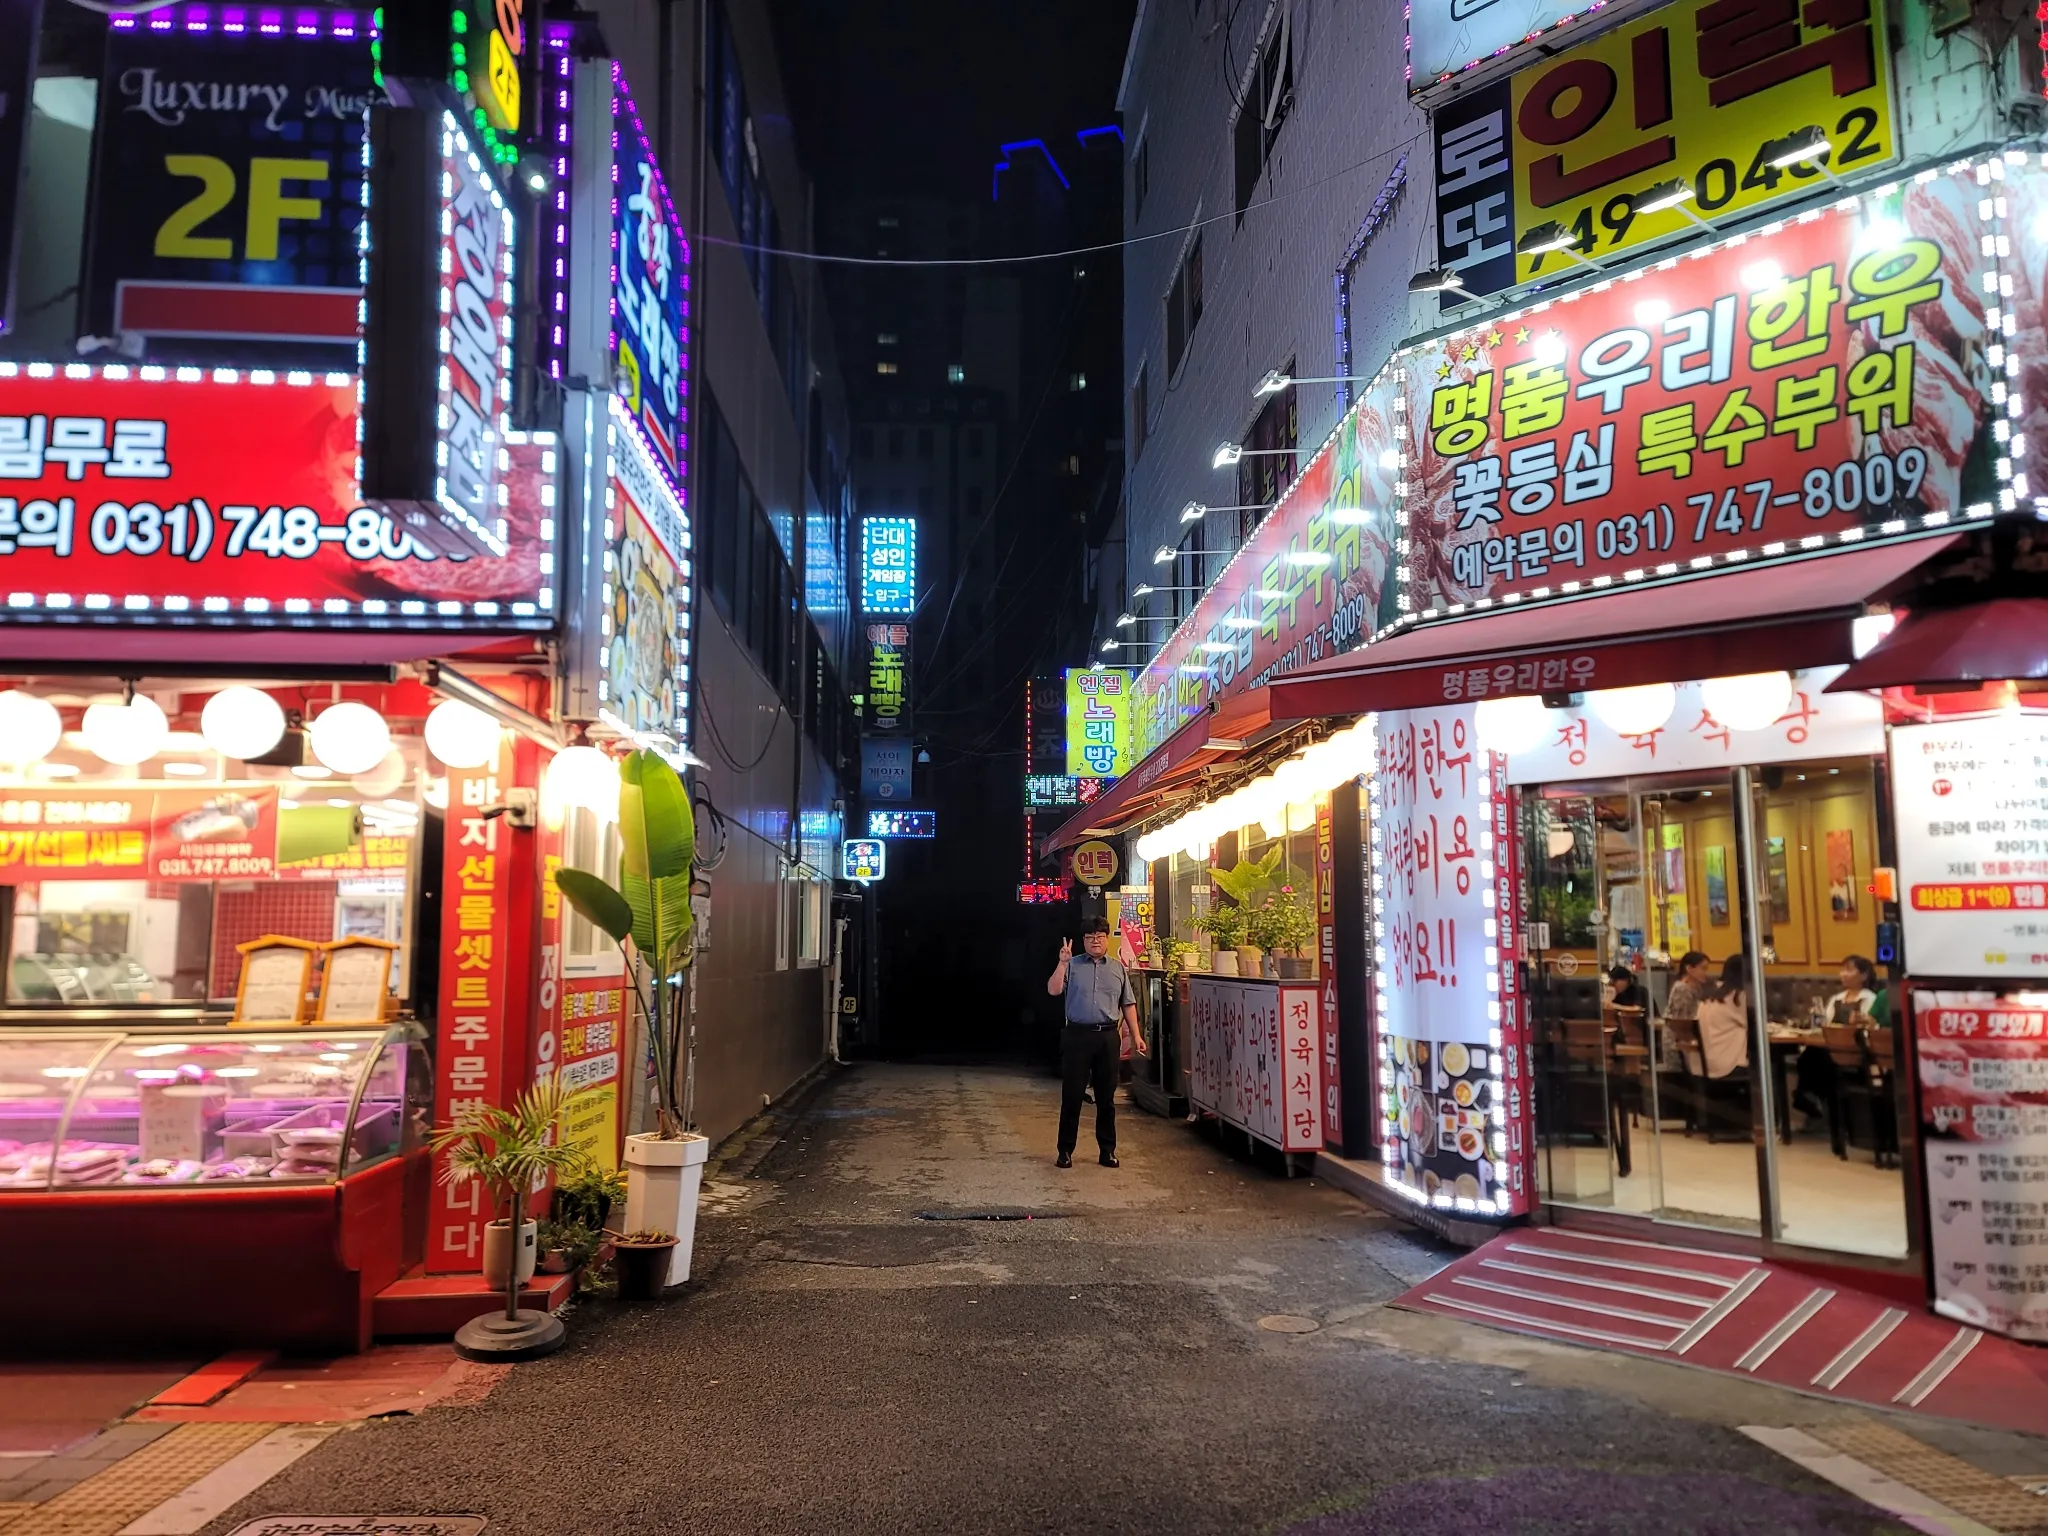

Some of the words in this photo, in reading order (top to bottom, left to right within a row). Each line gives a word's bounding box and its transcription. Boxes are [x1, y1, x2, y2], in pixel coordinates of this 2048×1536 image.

[119, 66, 289, 129] Luxury
[154, 154, 330, 262] 2F
[1438, 107, 1515, 265] 로또
[1431, 237, 1943, 457] 명품우리한우
[1454, 424, 1617, 532] 꽃등심
[1637, 343, 1917, 478] 특수부위
[0, 498, 75, 556] 의
[90, 502, 213, 562] 031)
[221, 505, 472, 563] 748-80
[871, 526, 906, 545] 단대
[1452, 520, 1586, 588] 예약문의
[1597, 504, 1675, 558] 031)
[1686, 447, 1928, 544] 747-8009
[868, 569, 907, 583] 게임장
[871, 548, 906, 566] 성인
[1261, 463, 1362, 641] 특수부위
[866, 624, 909, 645] 애플
[1305, 594, 1365, 666] 747-8009
[1077, 674, 1123, 695] 엔젤
[1441, 654, 1598, 700] 명품우리한우
[1084, 697, 1117, 773] 노래방
[858, 867, 869, 875] 2F
[1077, 850, 1113, 876] 인력
[844, 998, 855, 1010] 2F
[1289, 1000, 1316, 1139] 정육식당
